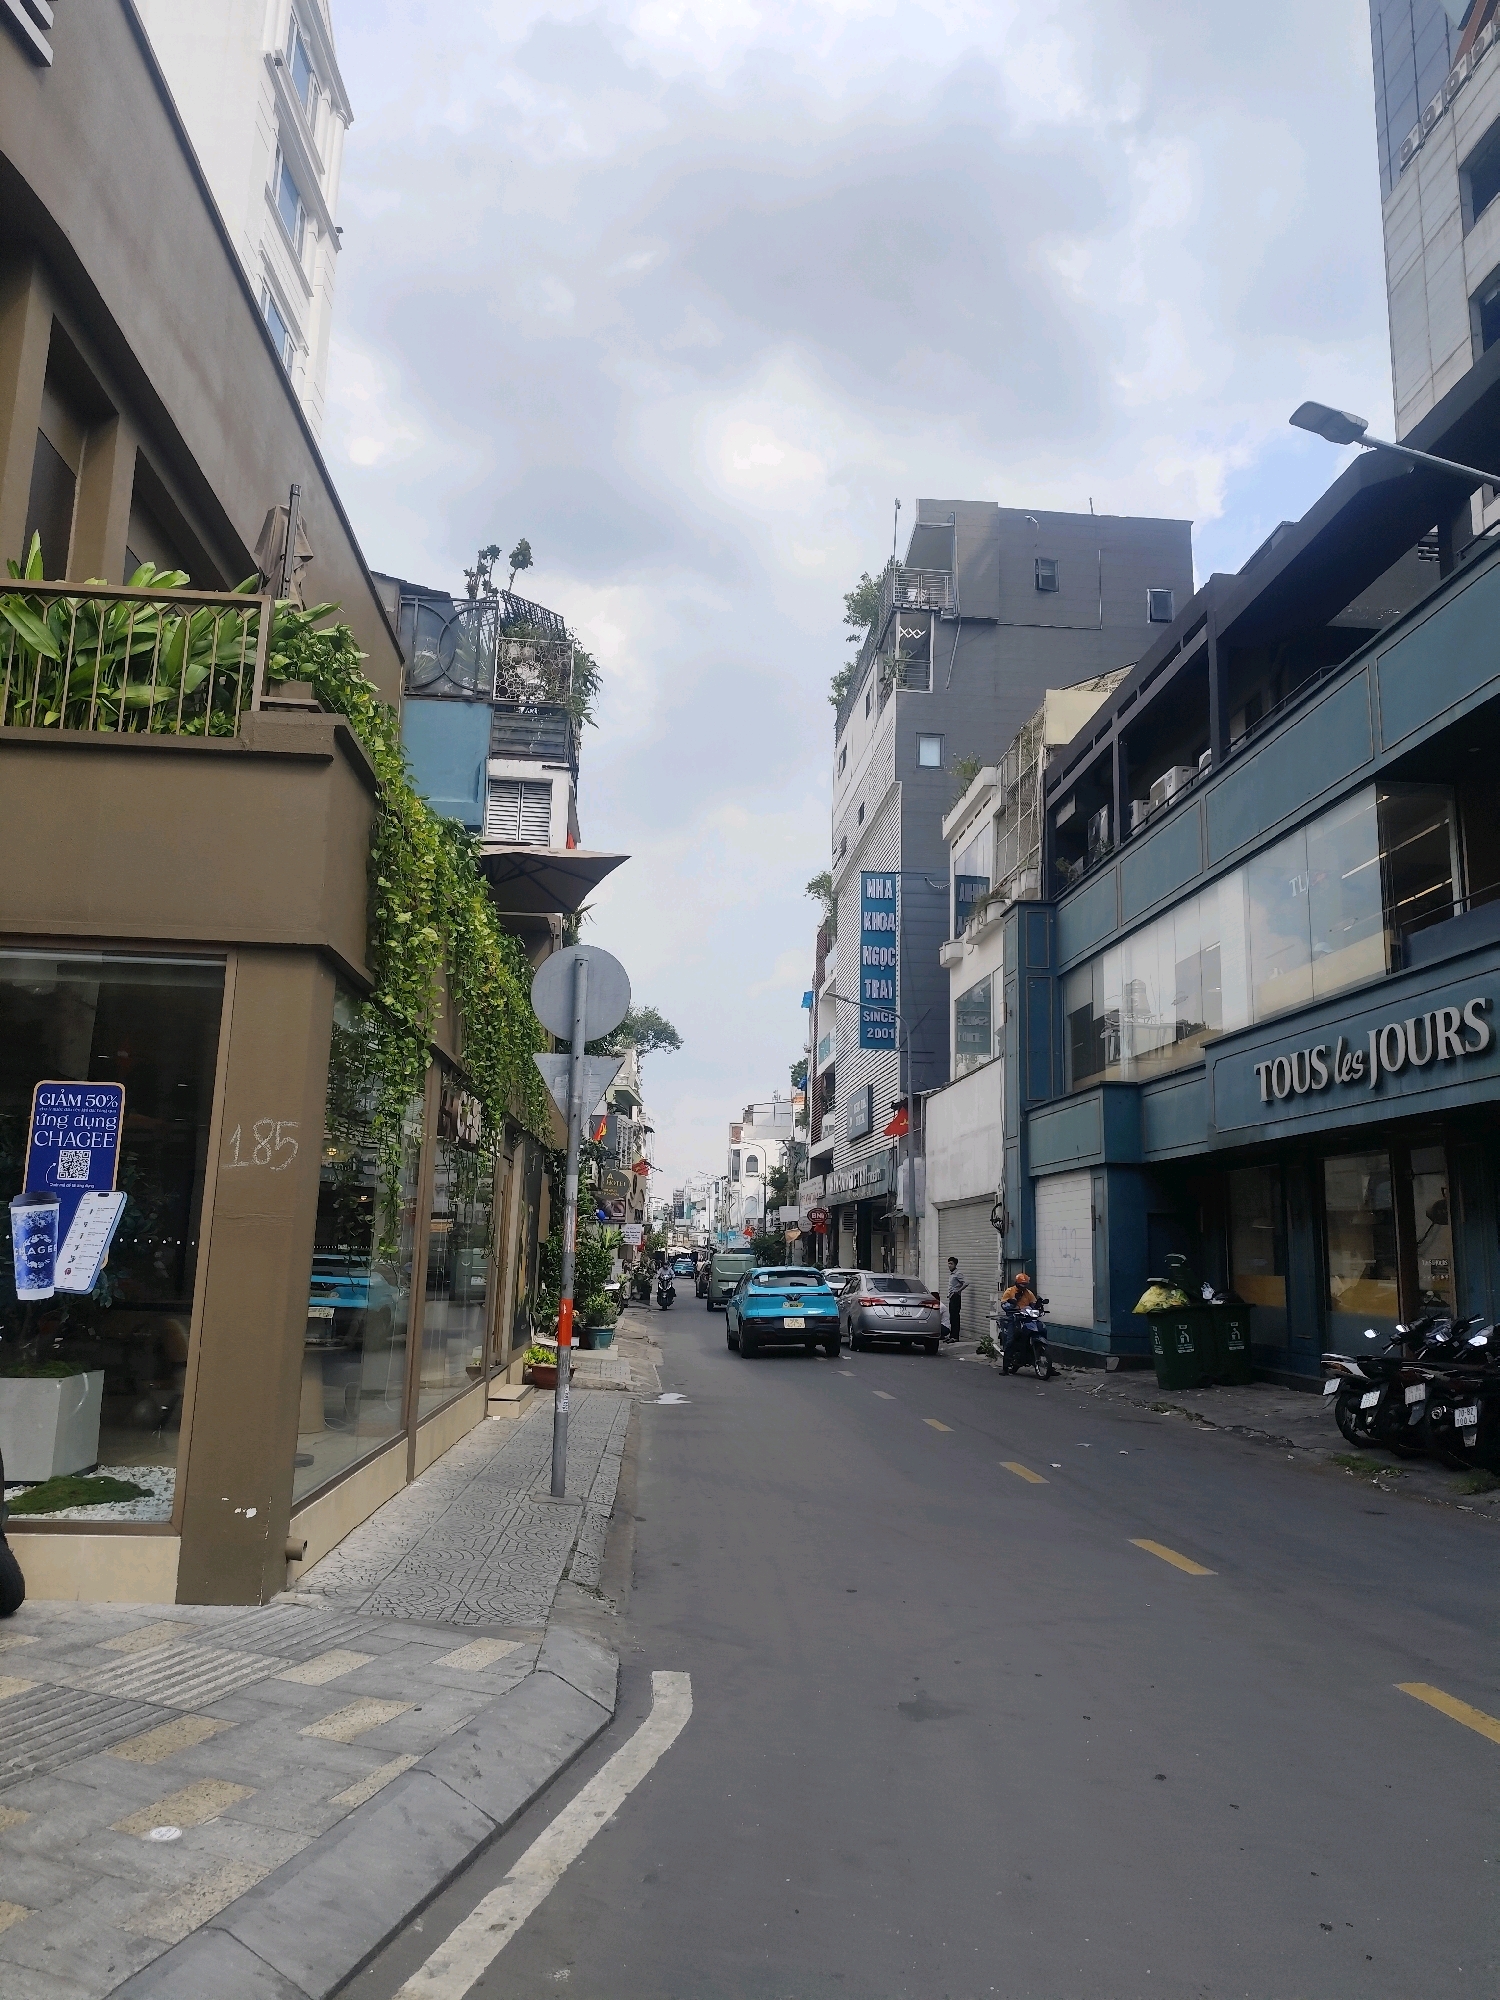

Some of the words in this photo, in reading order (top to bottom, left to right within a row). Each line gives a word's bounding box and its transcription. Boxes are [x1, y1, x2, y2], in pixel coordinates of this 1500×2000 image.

[866, 878, 893, 899] NHA
[863, 911, 896, 932] KHOA
[862, 945, 896, 971] NGỌC
[864, 979, 893, 1000] TRAI
[863, 1010, 895, 1023] SINCE
[867, 1028, 895, 1039] 2001
[1254, 1044, 1331, 1103] TOUS
[1334, 1034, 1366, 1085] les
[1366, 997, 1492, 1090] JOURS
[39, 1088, 82, 1107] GIẢM
[85, 1094, 119, 1108] 50%
[36, 1112, 69, 1130] ứng
[73, 1114, 118, 1131] dụng
[34, 1130, 116, 1148] CHAGEE
[221, 1118, 300, 1171] 185
